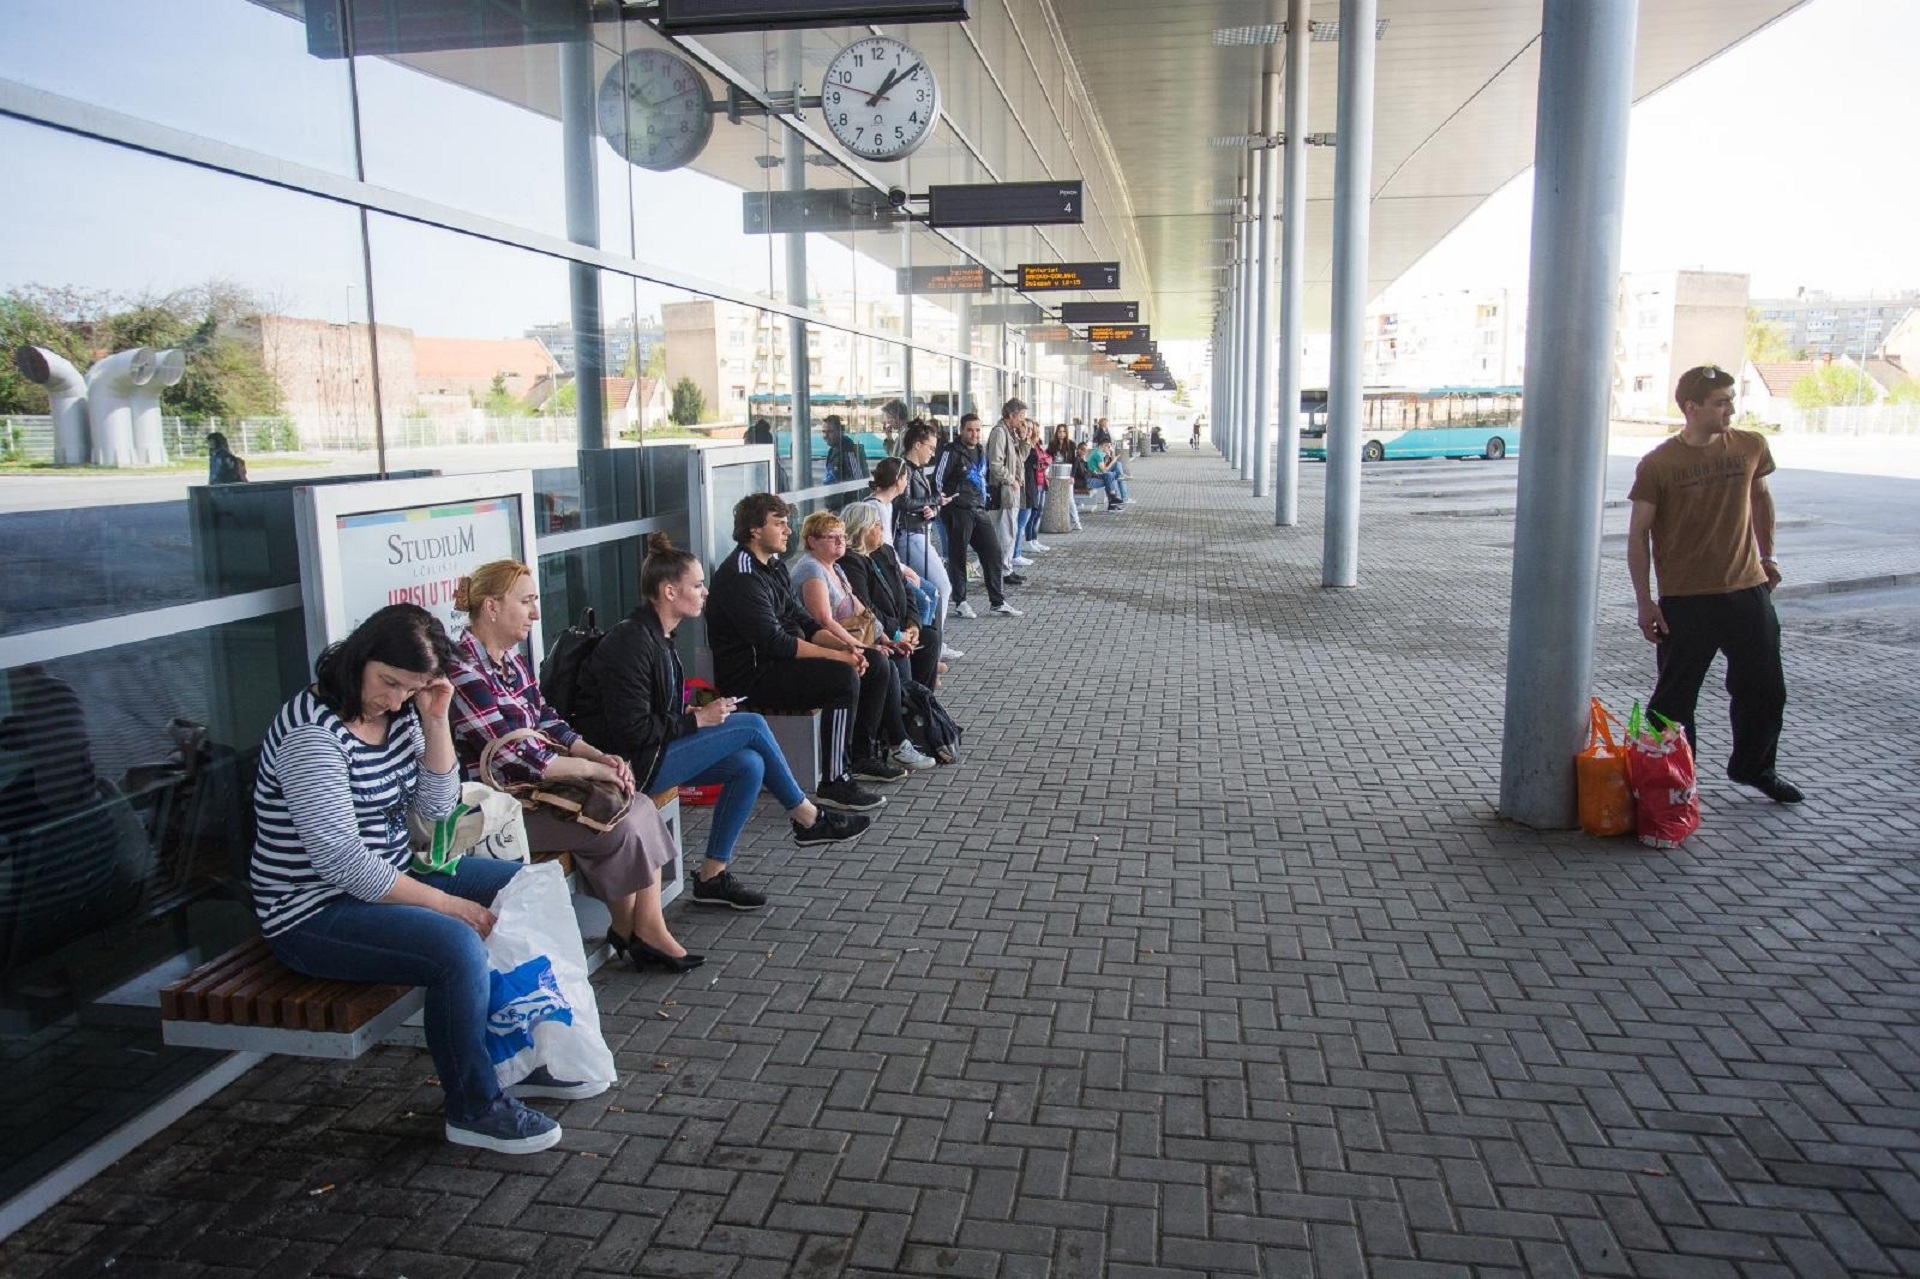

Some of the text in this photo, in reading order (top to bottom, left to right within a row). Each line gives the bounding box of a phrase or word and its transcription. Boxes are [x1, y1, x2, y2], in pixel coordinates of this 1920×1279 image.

[871, 47, 884, 61] 12
[895, 53, 901, 66] 1
[853, 54, 863, 68] 11
[838, 70, 852, 84] 10
[832, 91, 841, 104] 9
[916, 89, 925, 103] 3
[839, 113, 848, 126] 8
[908, 111, 918, 124] 4
[855, 127, 864, 141] 7
[894, 126, 904, 139] 5
[874, 133, 883, 146] 6
[1063, 202, 1073, 213] 4
[1107, 275, 1113, 283] 5
[430, 582, 438, 606] U
